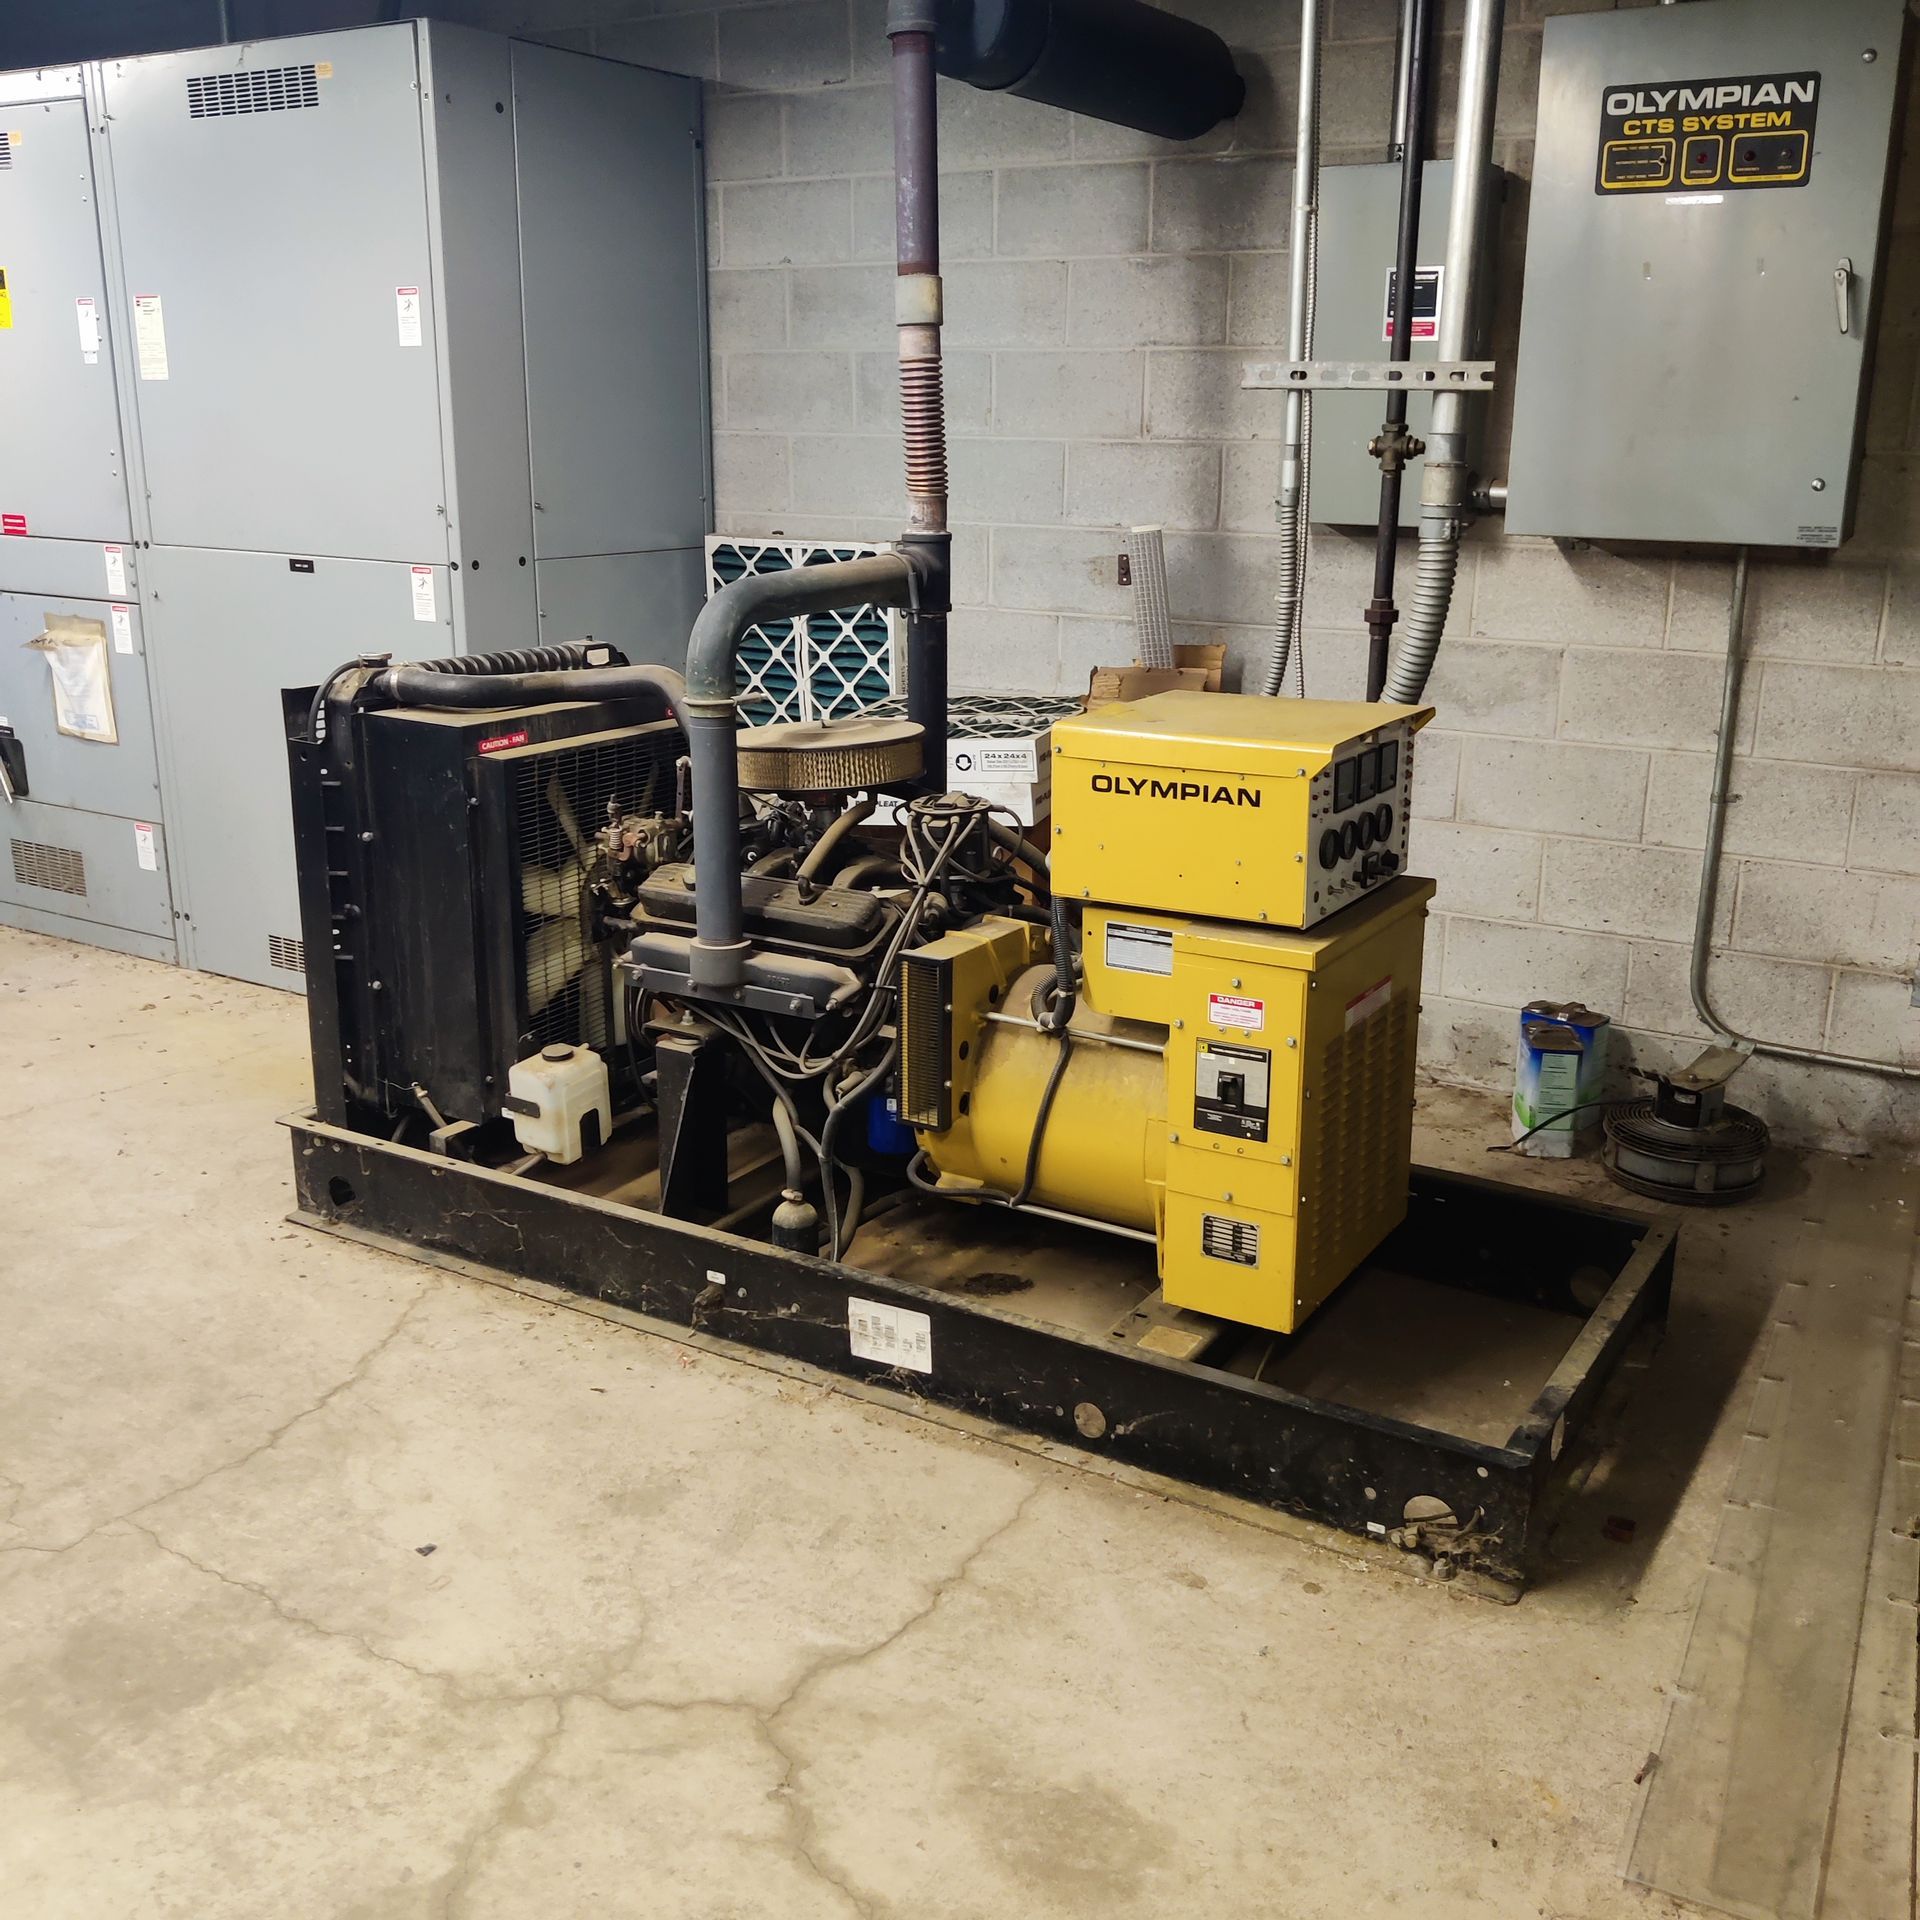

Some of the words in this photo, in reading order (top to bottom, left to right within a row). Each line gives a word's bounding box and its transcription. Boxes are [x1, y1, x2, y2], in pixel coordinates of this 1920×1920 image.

[1607, 80, 1815, 116] OLYMPIAN
[1623, 118, 1675, 135] CTS
[1682, 111, 1792, 132] SYSTEM
[481, 738, 509, 750] CAUTION
[512, 734, 525, 743] FAN
[1091, 774, 1261, 807] OLYMPIAN
[1216, 996, 1256, 1008] DANGER
